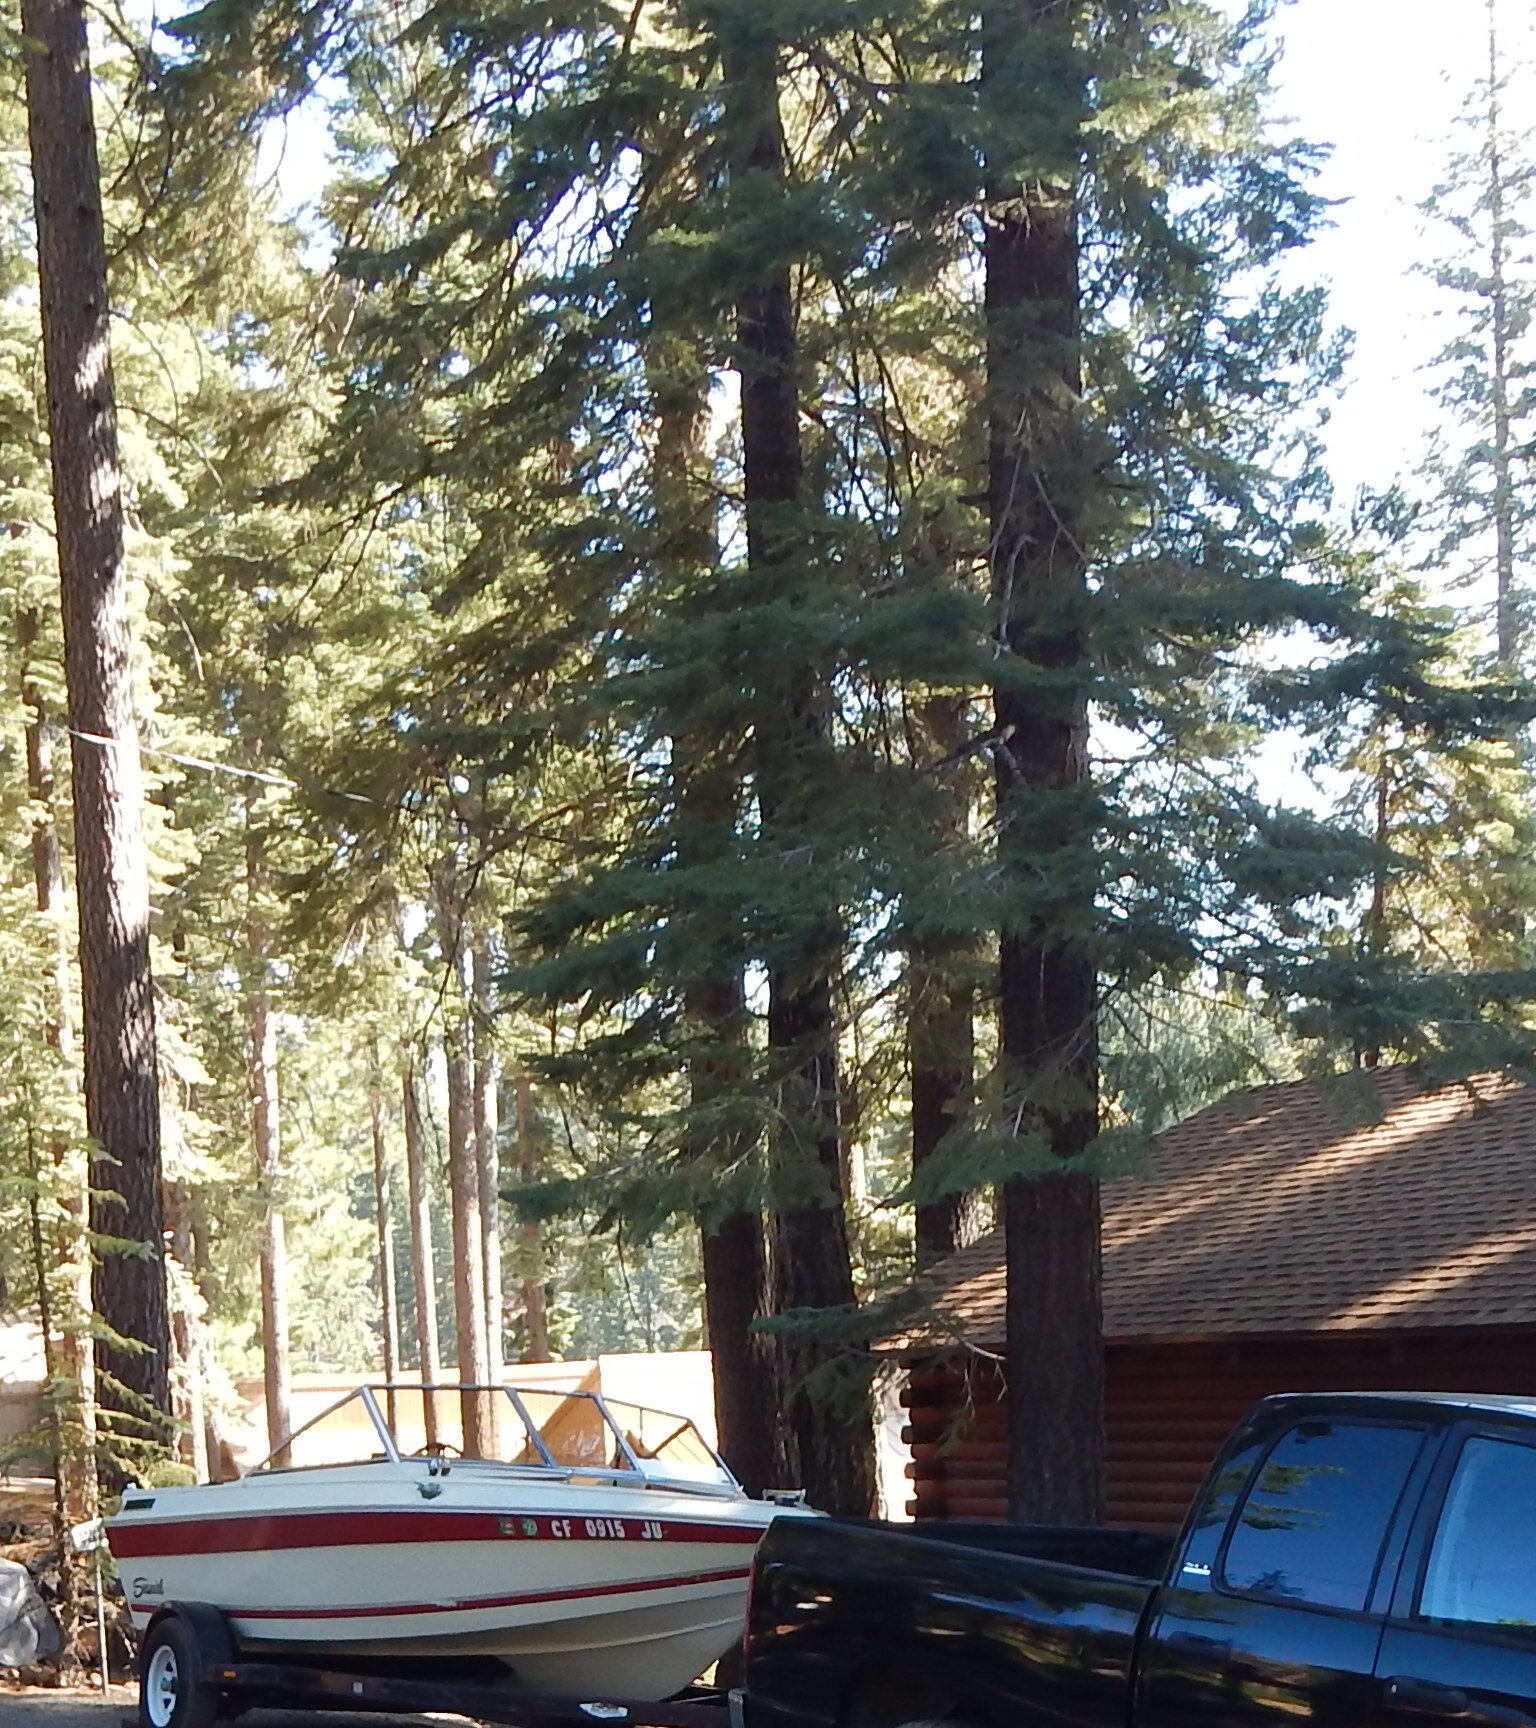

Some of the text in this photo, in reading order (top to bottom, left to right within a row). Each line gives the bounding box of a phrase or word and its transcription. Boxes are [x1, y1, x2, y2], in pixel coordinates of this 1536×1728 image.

[551, 1519, 571, 1538] CF
[585, 1519, 626, 1538] 0915
[641, 1520, 663, 1539] JU
